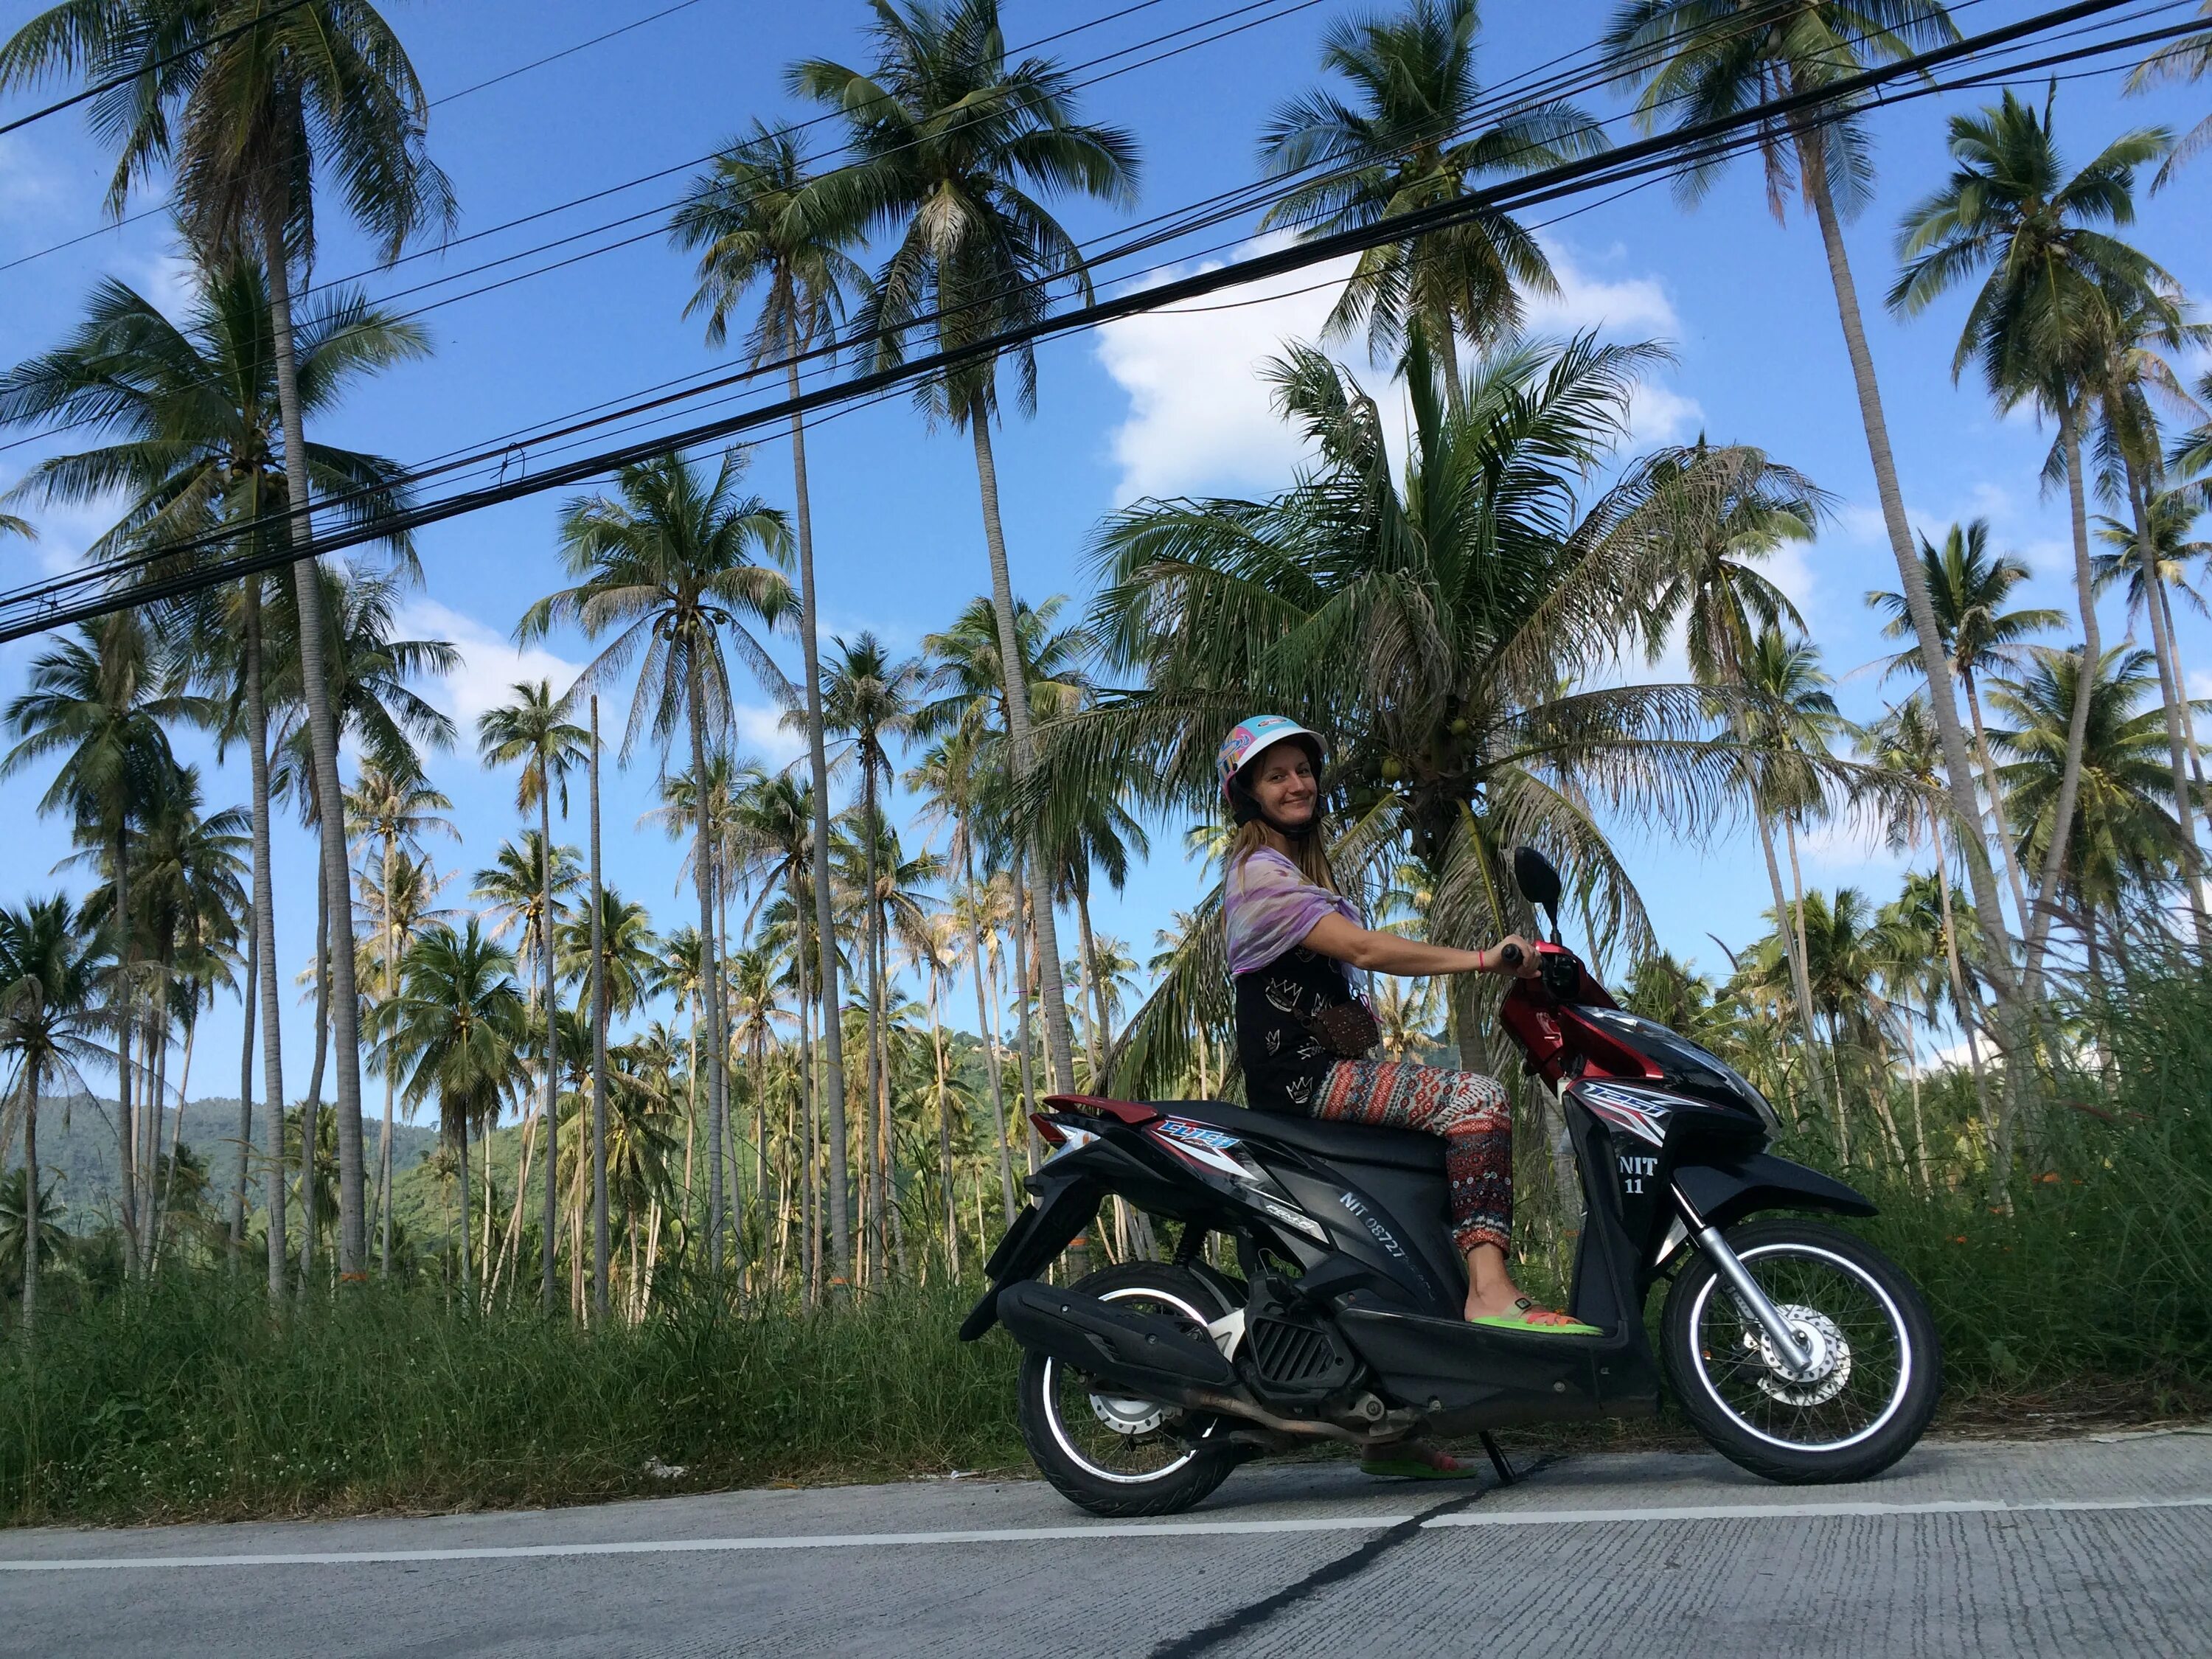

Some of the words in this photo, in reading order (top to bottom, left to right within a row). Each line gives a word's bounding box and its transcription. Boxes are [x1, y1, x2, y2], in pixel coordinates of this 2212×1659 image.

[1158, 1120, 1240, 1149] CLICK
[1620, 1156, 1658, 1176] NIT
[1625, 1179, 1644, 1194] 11
[1339, 1192, 1369, 1217] NIT
[1365, 1217, 1406, 1258] 08727
